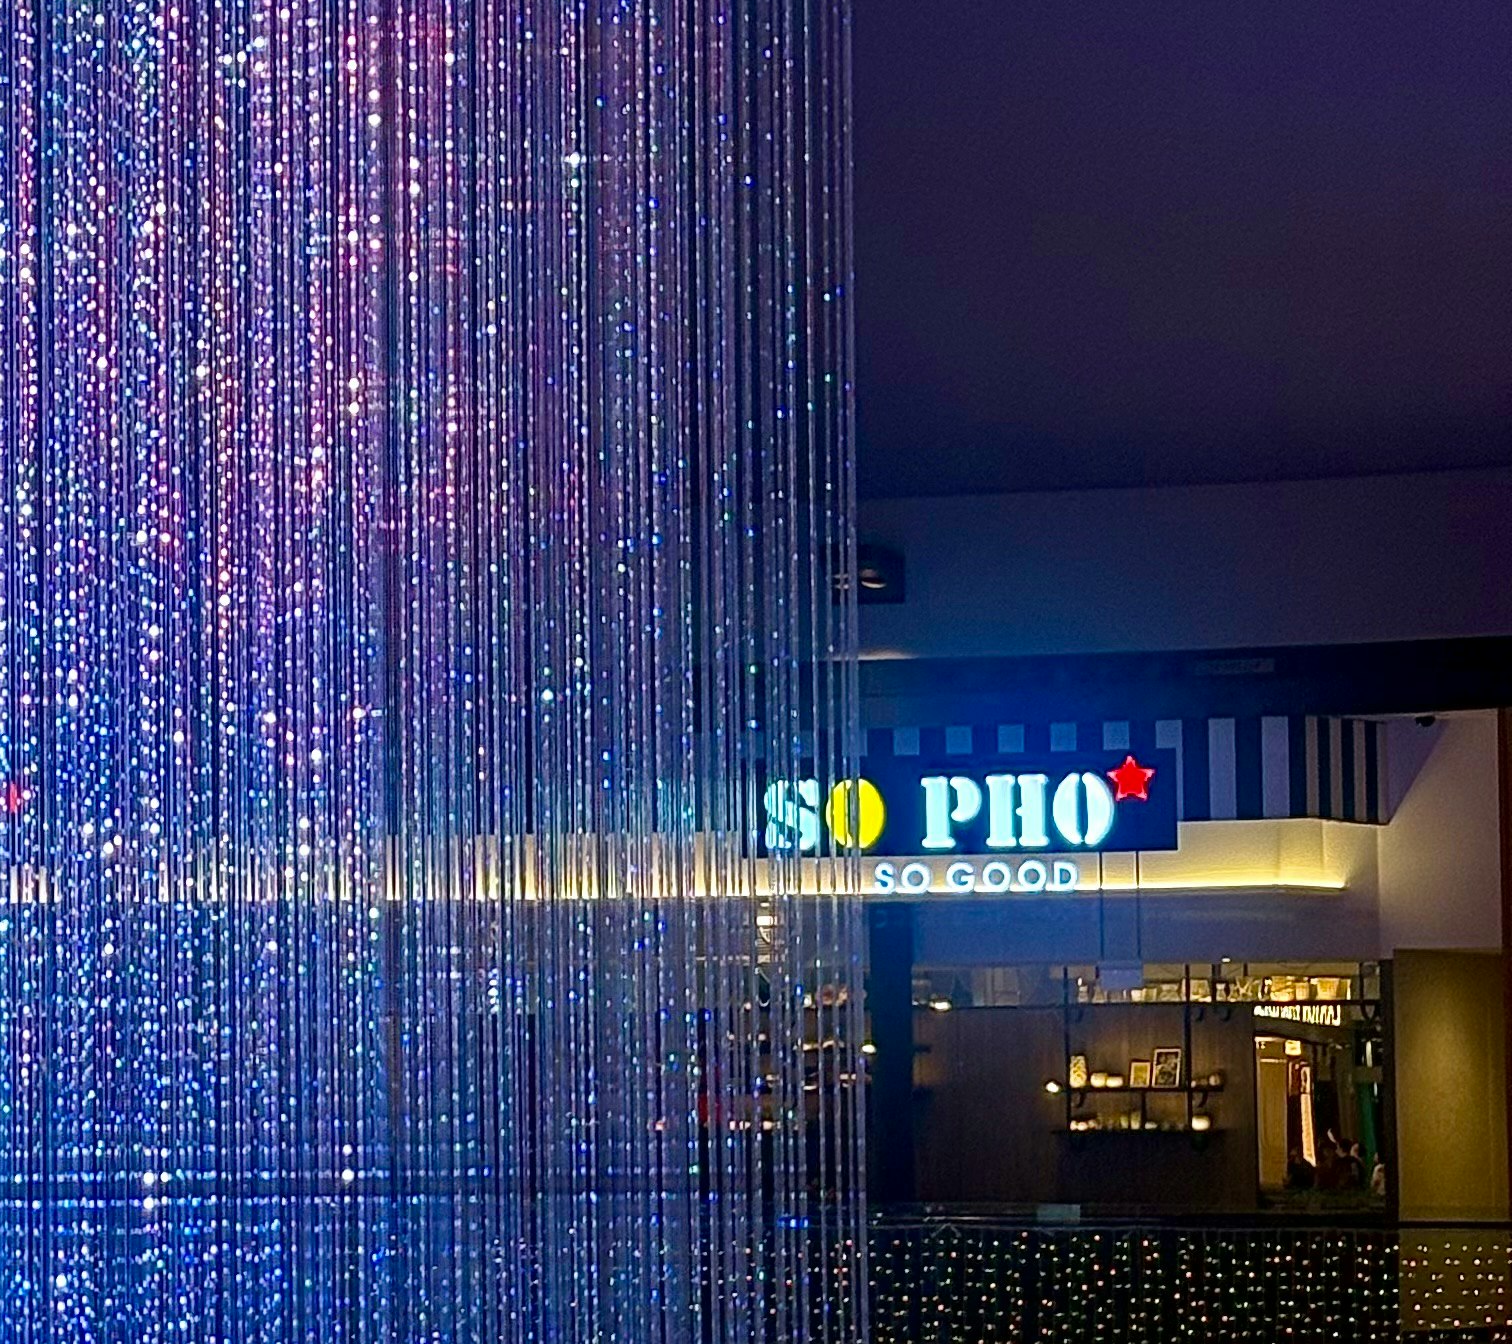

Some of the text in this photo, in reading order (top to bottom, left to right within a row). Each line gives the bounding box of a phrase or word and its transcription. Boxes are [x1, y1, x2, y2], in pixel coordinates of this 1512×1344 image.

[764, 771, 1116, 851] SO PHO
[874, 859, 1079, 893] SO GOOD
